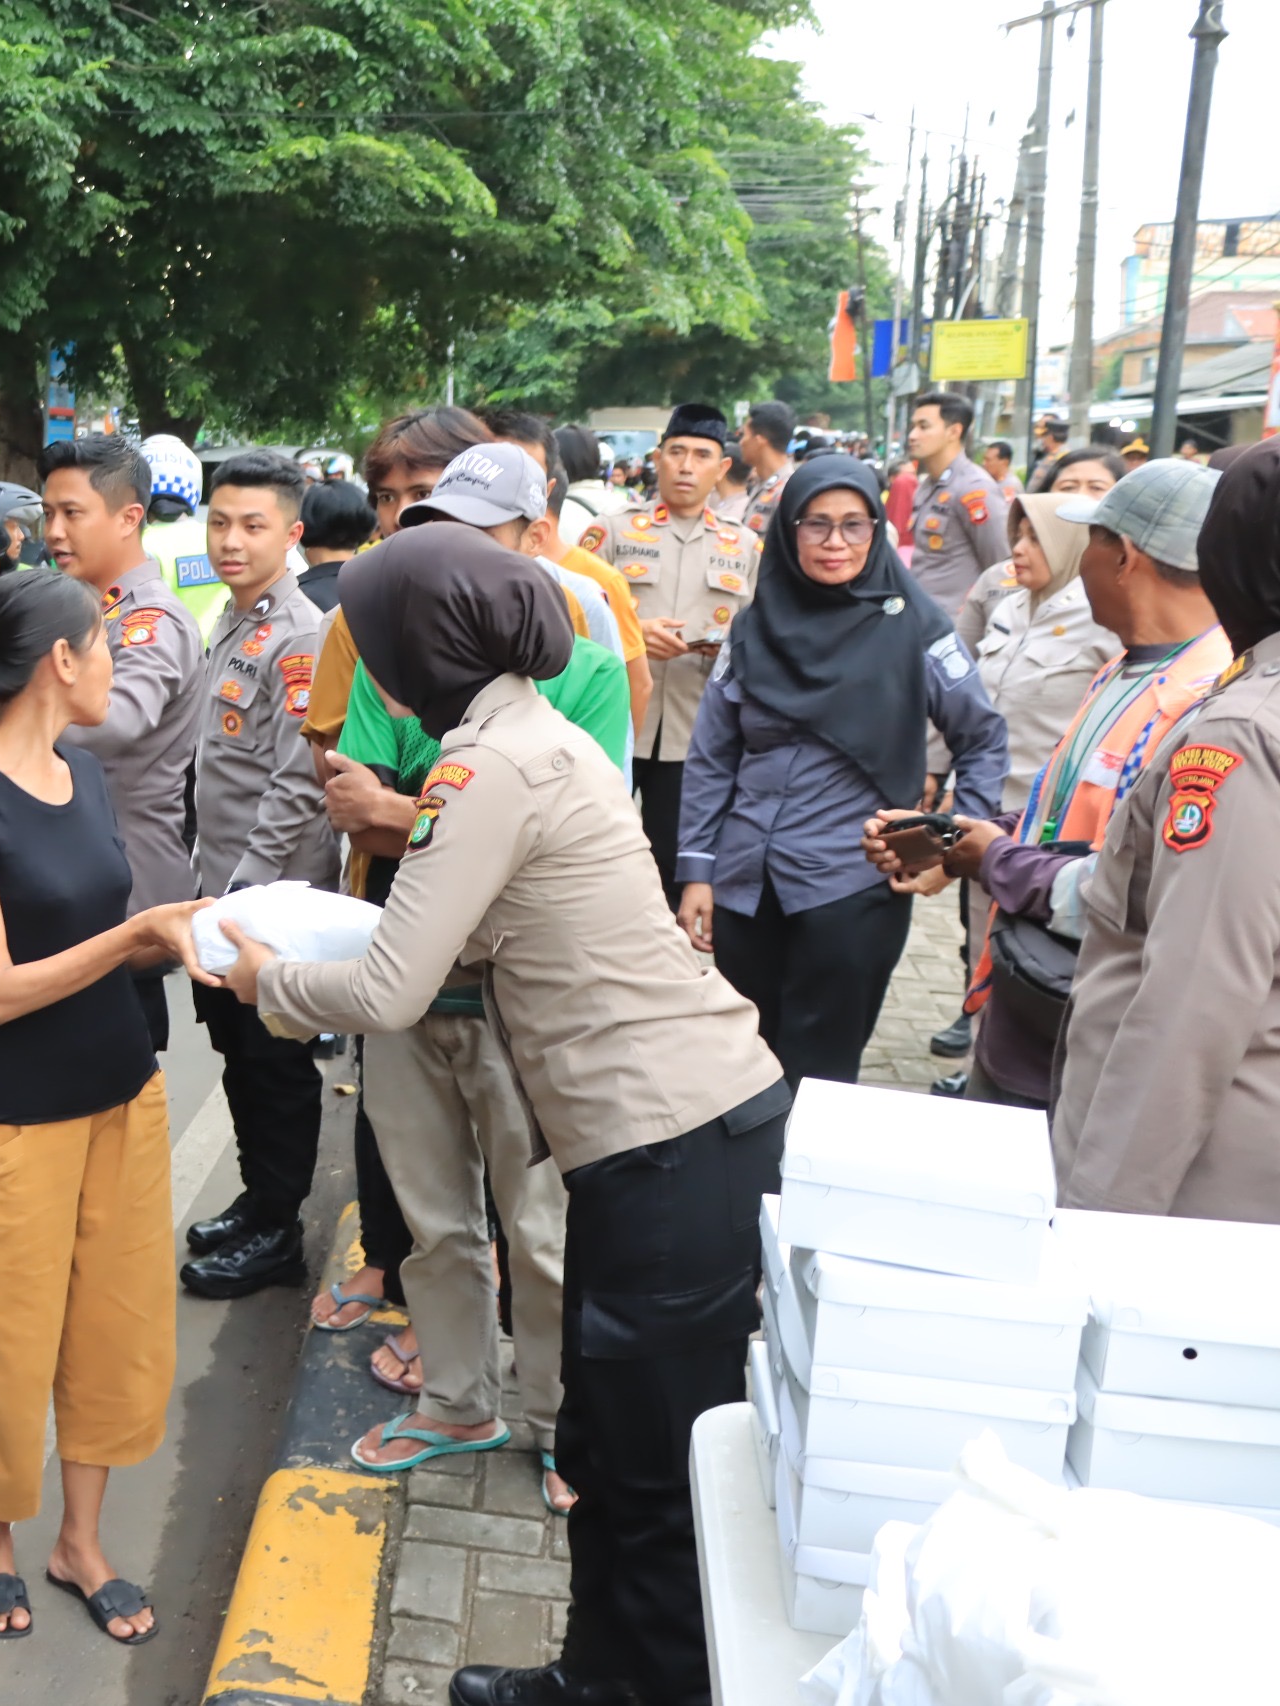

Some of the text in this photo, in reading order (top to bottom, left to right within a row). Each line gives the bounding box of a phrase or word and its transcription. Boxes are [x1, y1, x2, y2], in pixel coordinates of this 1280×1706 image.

[145, 453, 183, 465] OLISI
[178, 560, 215, 581] POLI
[709, 556, 747, 571] POLRI
[227, 656, 258, 680] POLRI
